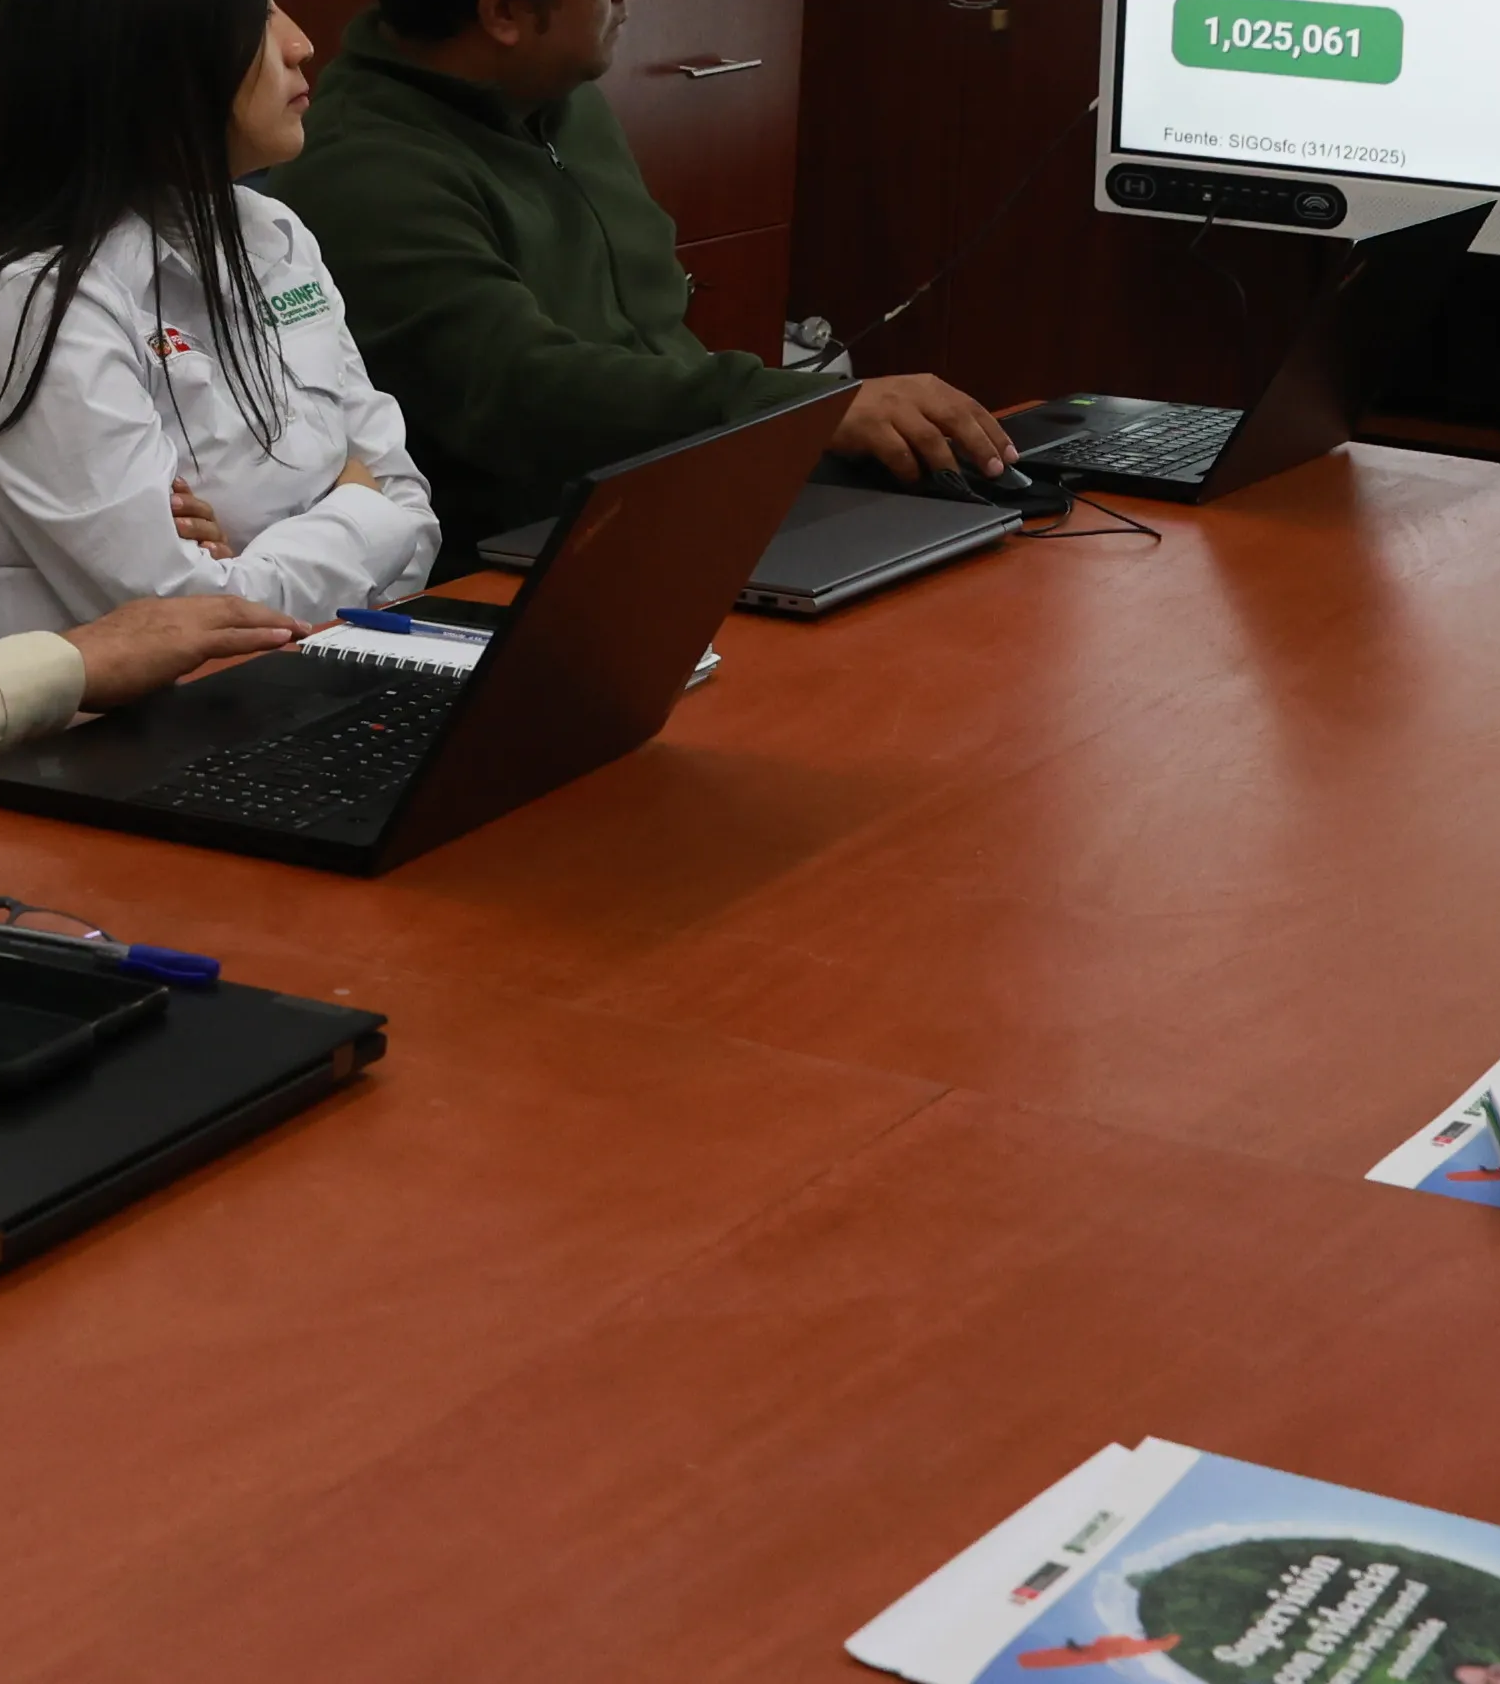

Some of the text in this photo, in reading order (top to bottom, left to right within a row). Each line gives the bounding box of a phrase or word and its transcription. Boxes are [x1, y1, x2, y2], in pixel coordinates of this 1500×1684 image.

[1204, 16, 1362, 59] 1,025,061
[1163, 127, 1406, 167] Fuente: SIGOsfc (31/12/2025)
